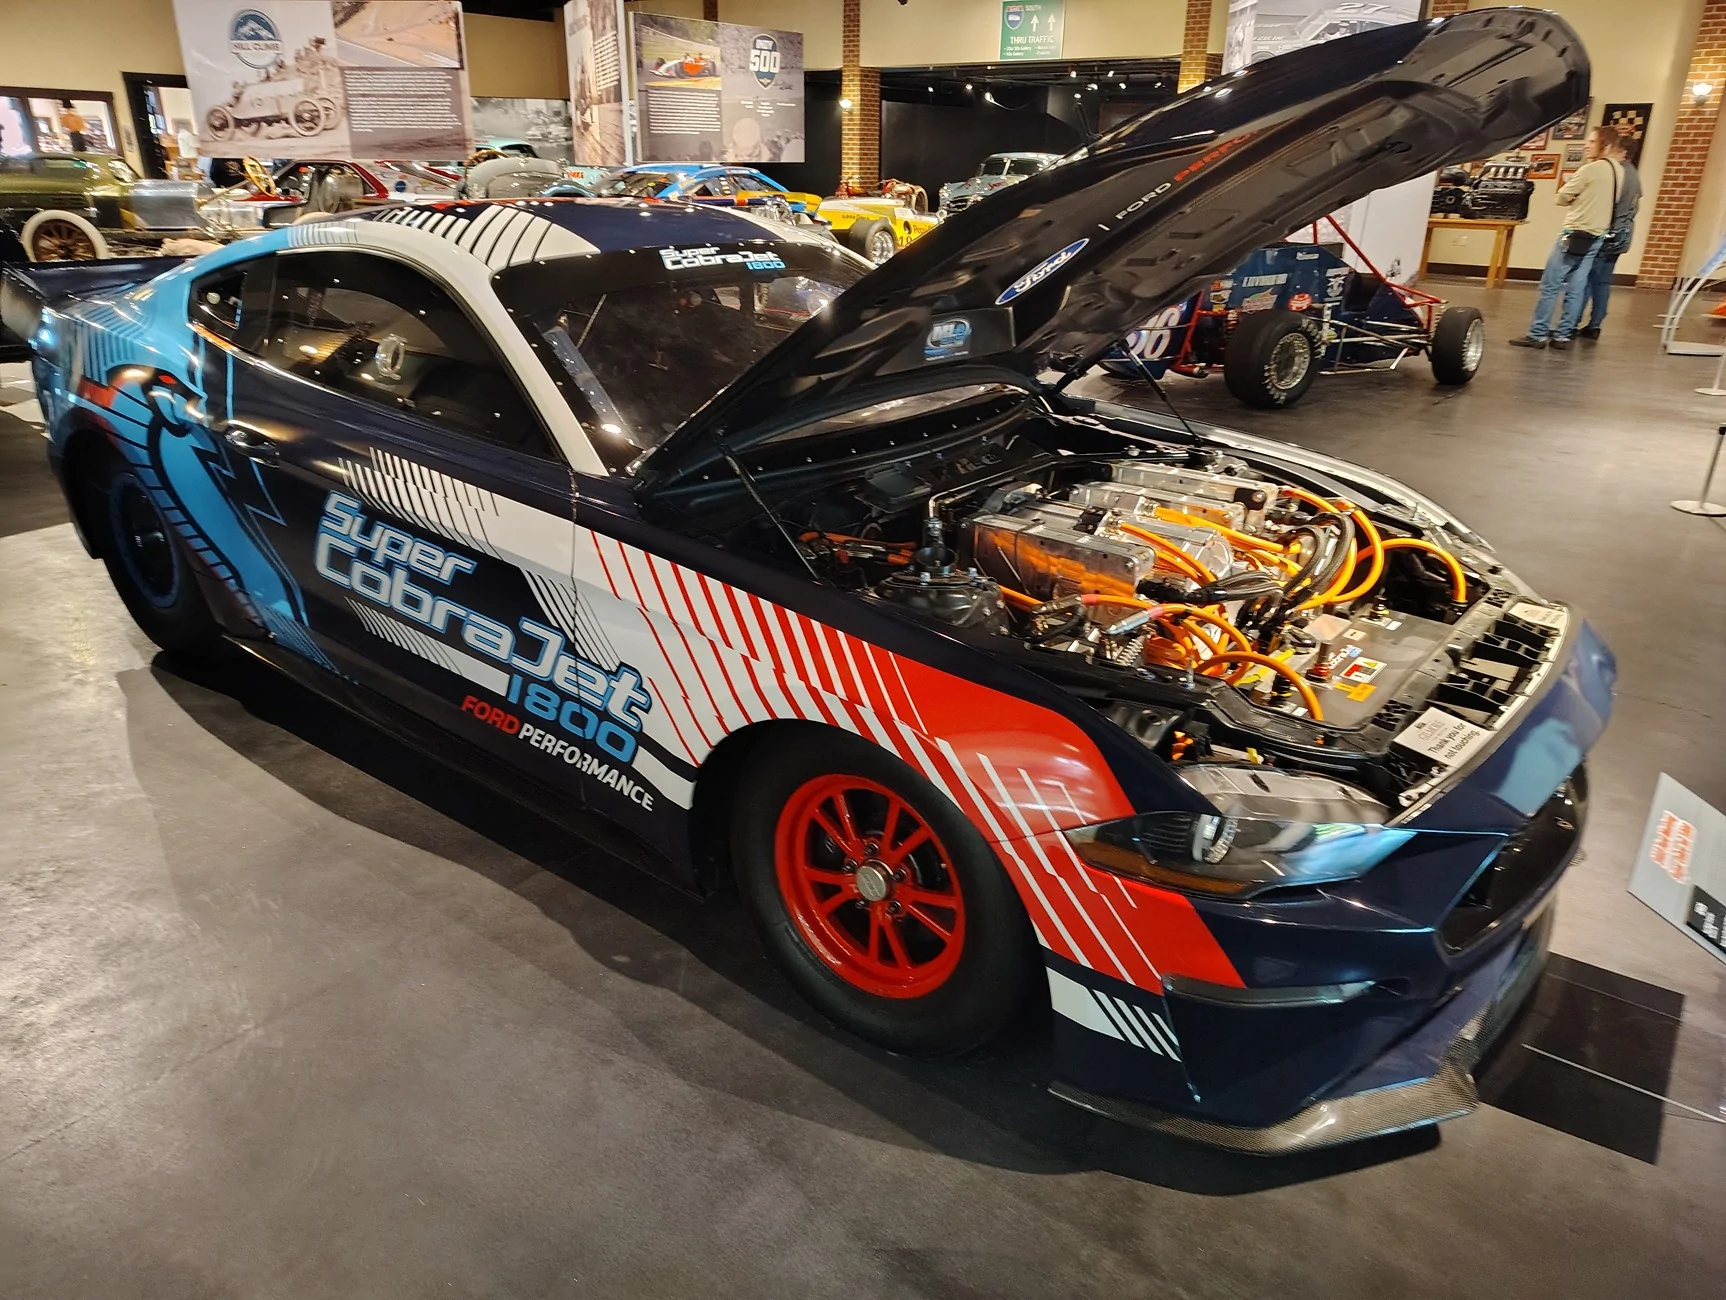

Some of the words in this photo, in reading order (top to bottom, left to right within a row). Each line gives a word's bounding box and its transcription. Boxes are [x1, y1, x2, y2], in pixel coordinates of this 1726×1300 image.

[1010, 36, 1027, 44] THRU
[1028, 35, 1054, 44] TRAFFIC
[749, 48, 781, 74] 500
[1115, 182, 1172, 220] FORD
[659, 246, 720, 258] Super
[661, 250, 782, 271] CobraJet
[745, 260, 786, 270] 1800
[1014, 251, 1071, 293] Ford
[322, 489, 478, 585] Super
[314, 531, 652, 732] CobraJet
[506, 674, 639, 764] 1800
[1427, 736, 1451, 754] Thank
[1453, 730, 1480, 750] touching.
[461, 695, 521, 736] FORD
[518, 722, 655, 812] PERFORMANCE
